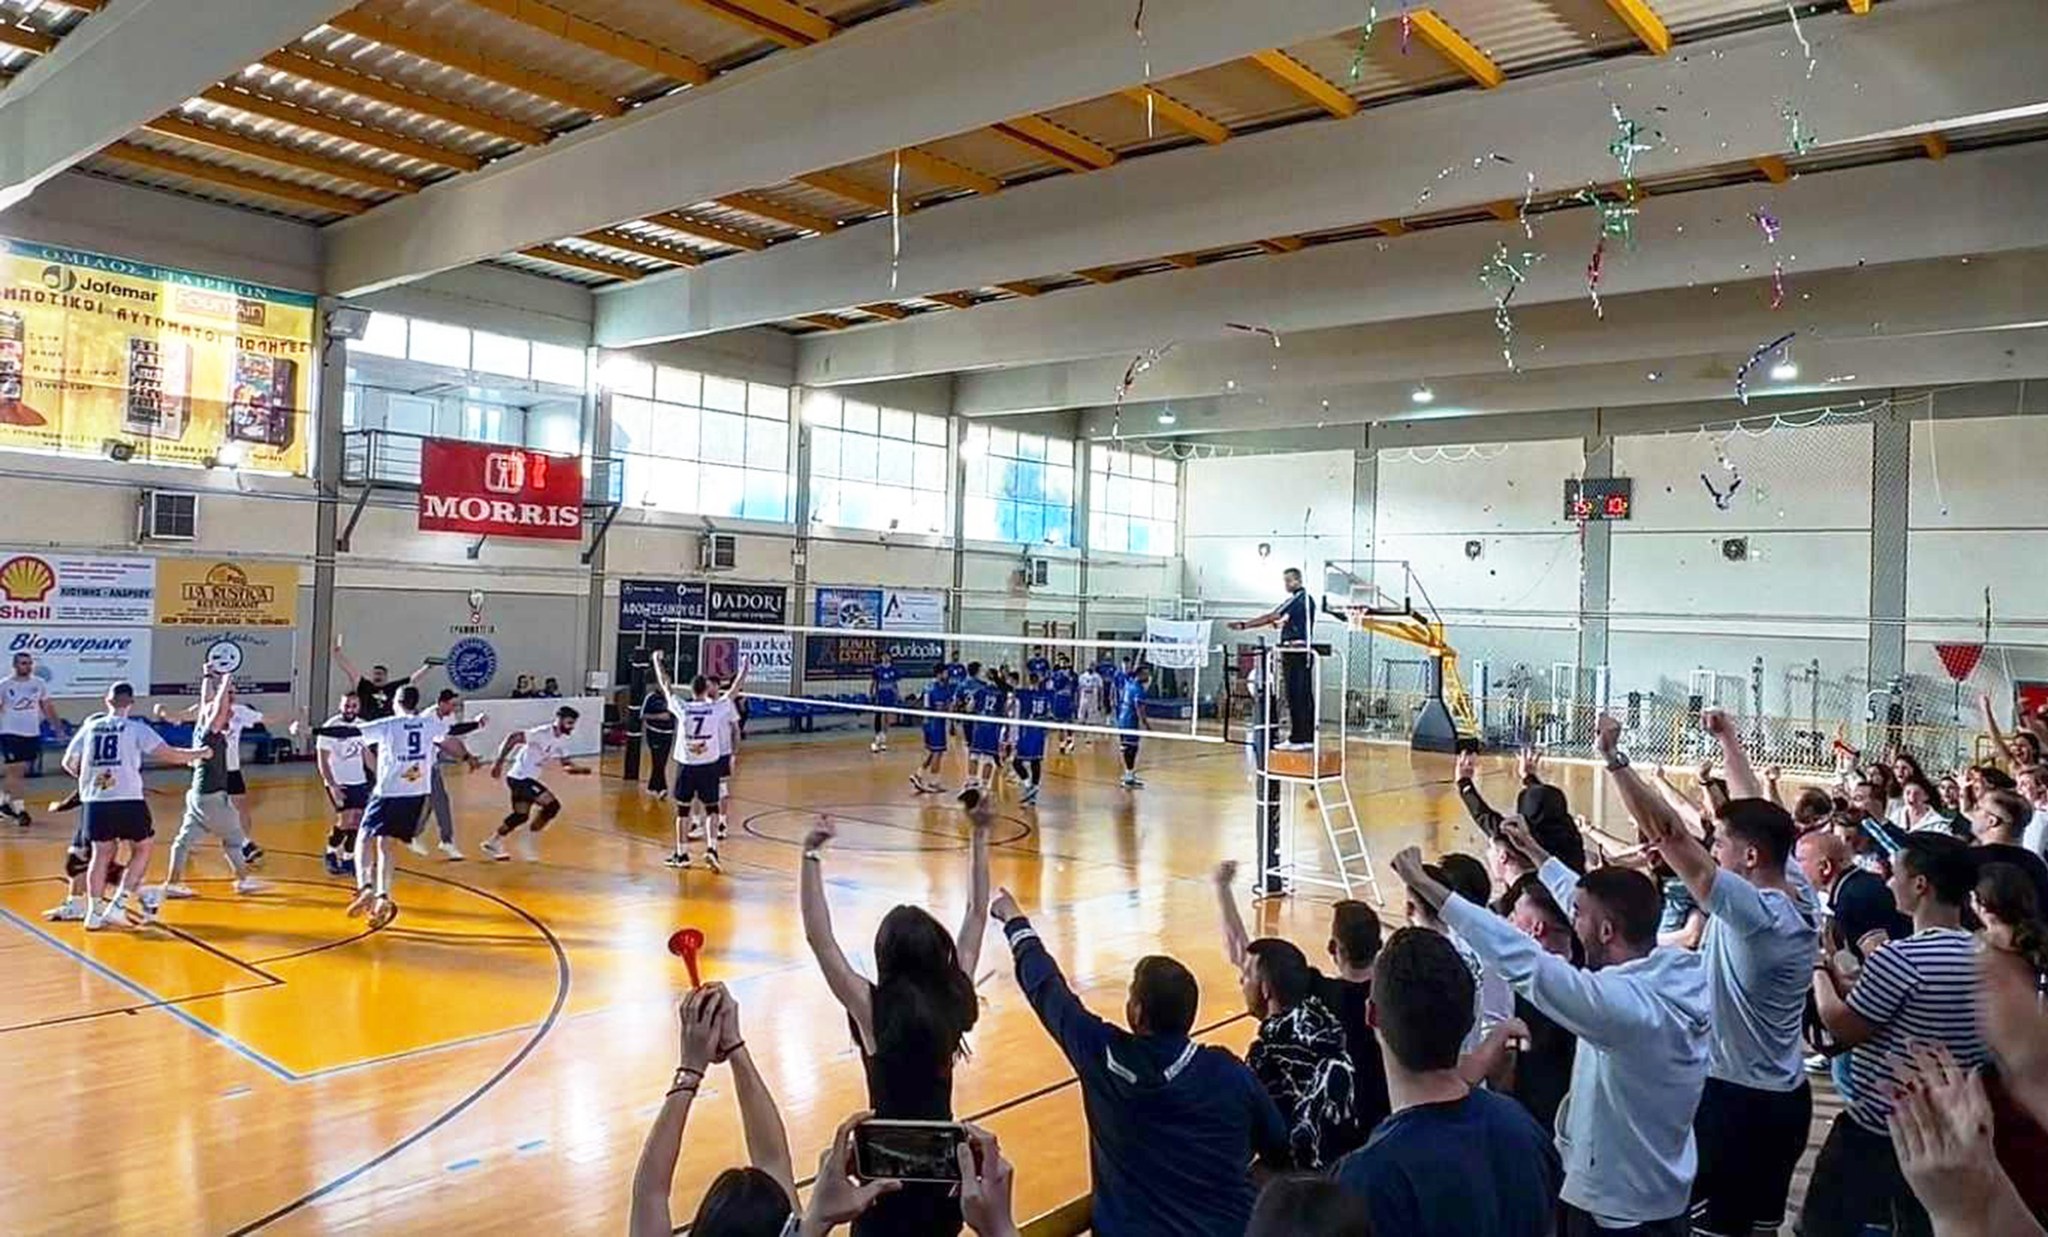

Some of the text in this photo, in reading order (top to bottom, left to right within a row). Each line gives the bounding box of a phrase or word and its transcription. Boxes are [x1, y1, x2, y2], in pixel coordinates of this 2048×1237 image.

[80, 276, 159, 303] Jofemar
[423, 495, 579, 527] MORRIS
[0, 605, 51, 620] Shell
[10, 633, 132, 653] Bioprepare
[693, 717, 705, 735] 7
[94, 735, 118, 760] 18
[408, 731, 421, 754] 9
